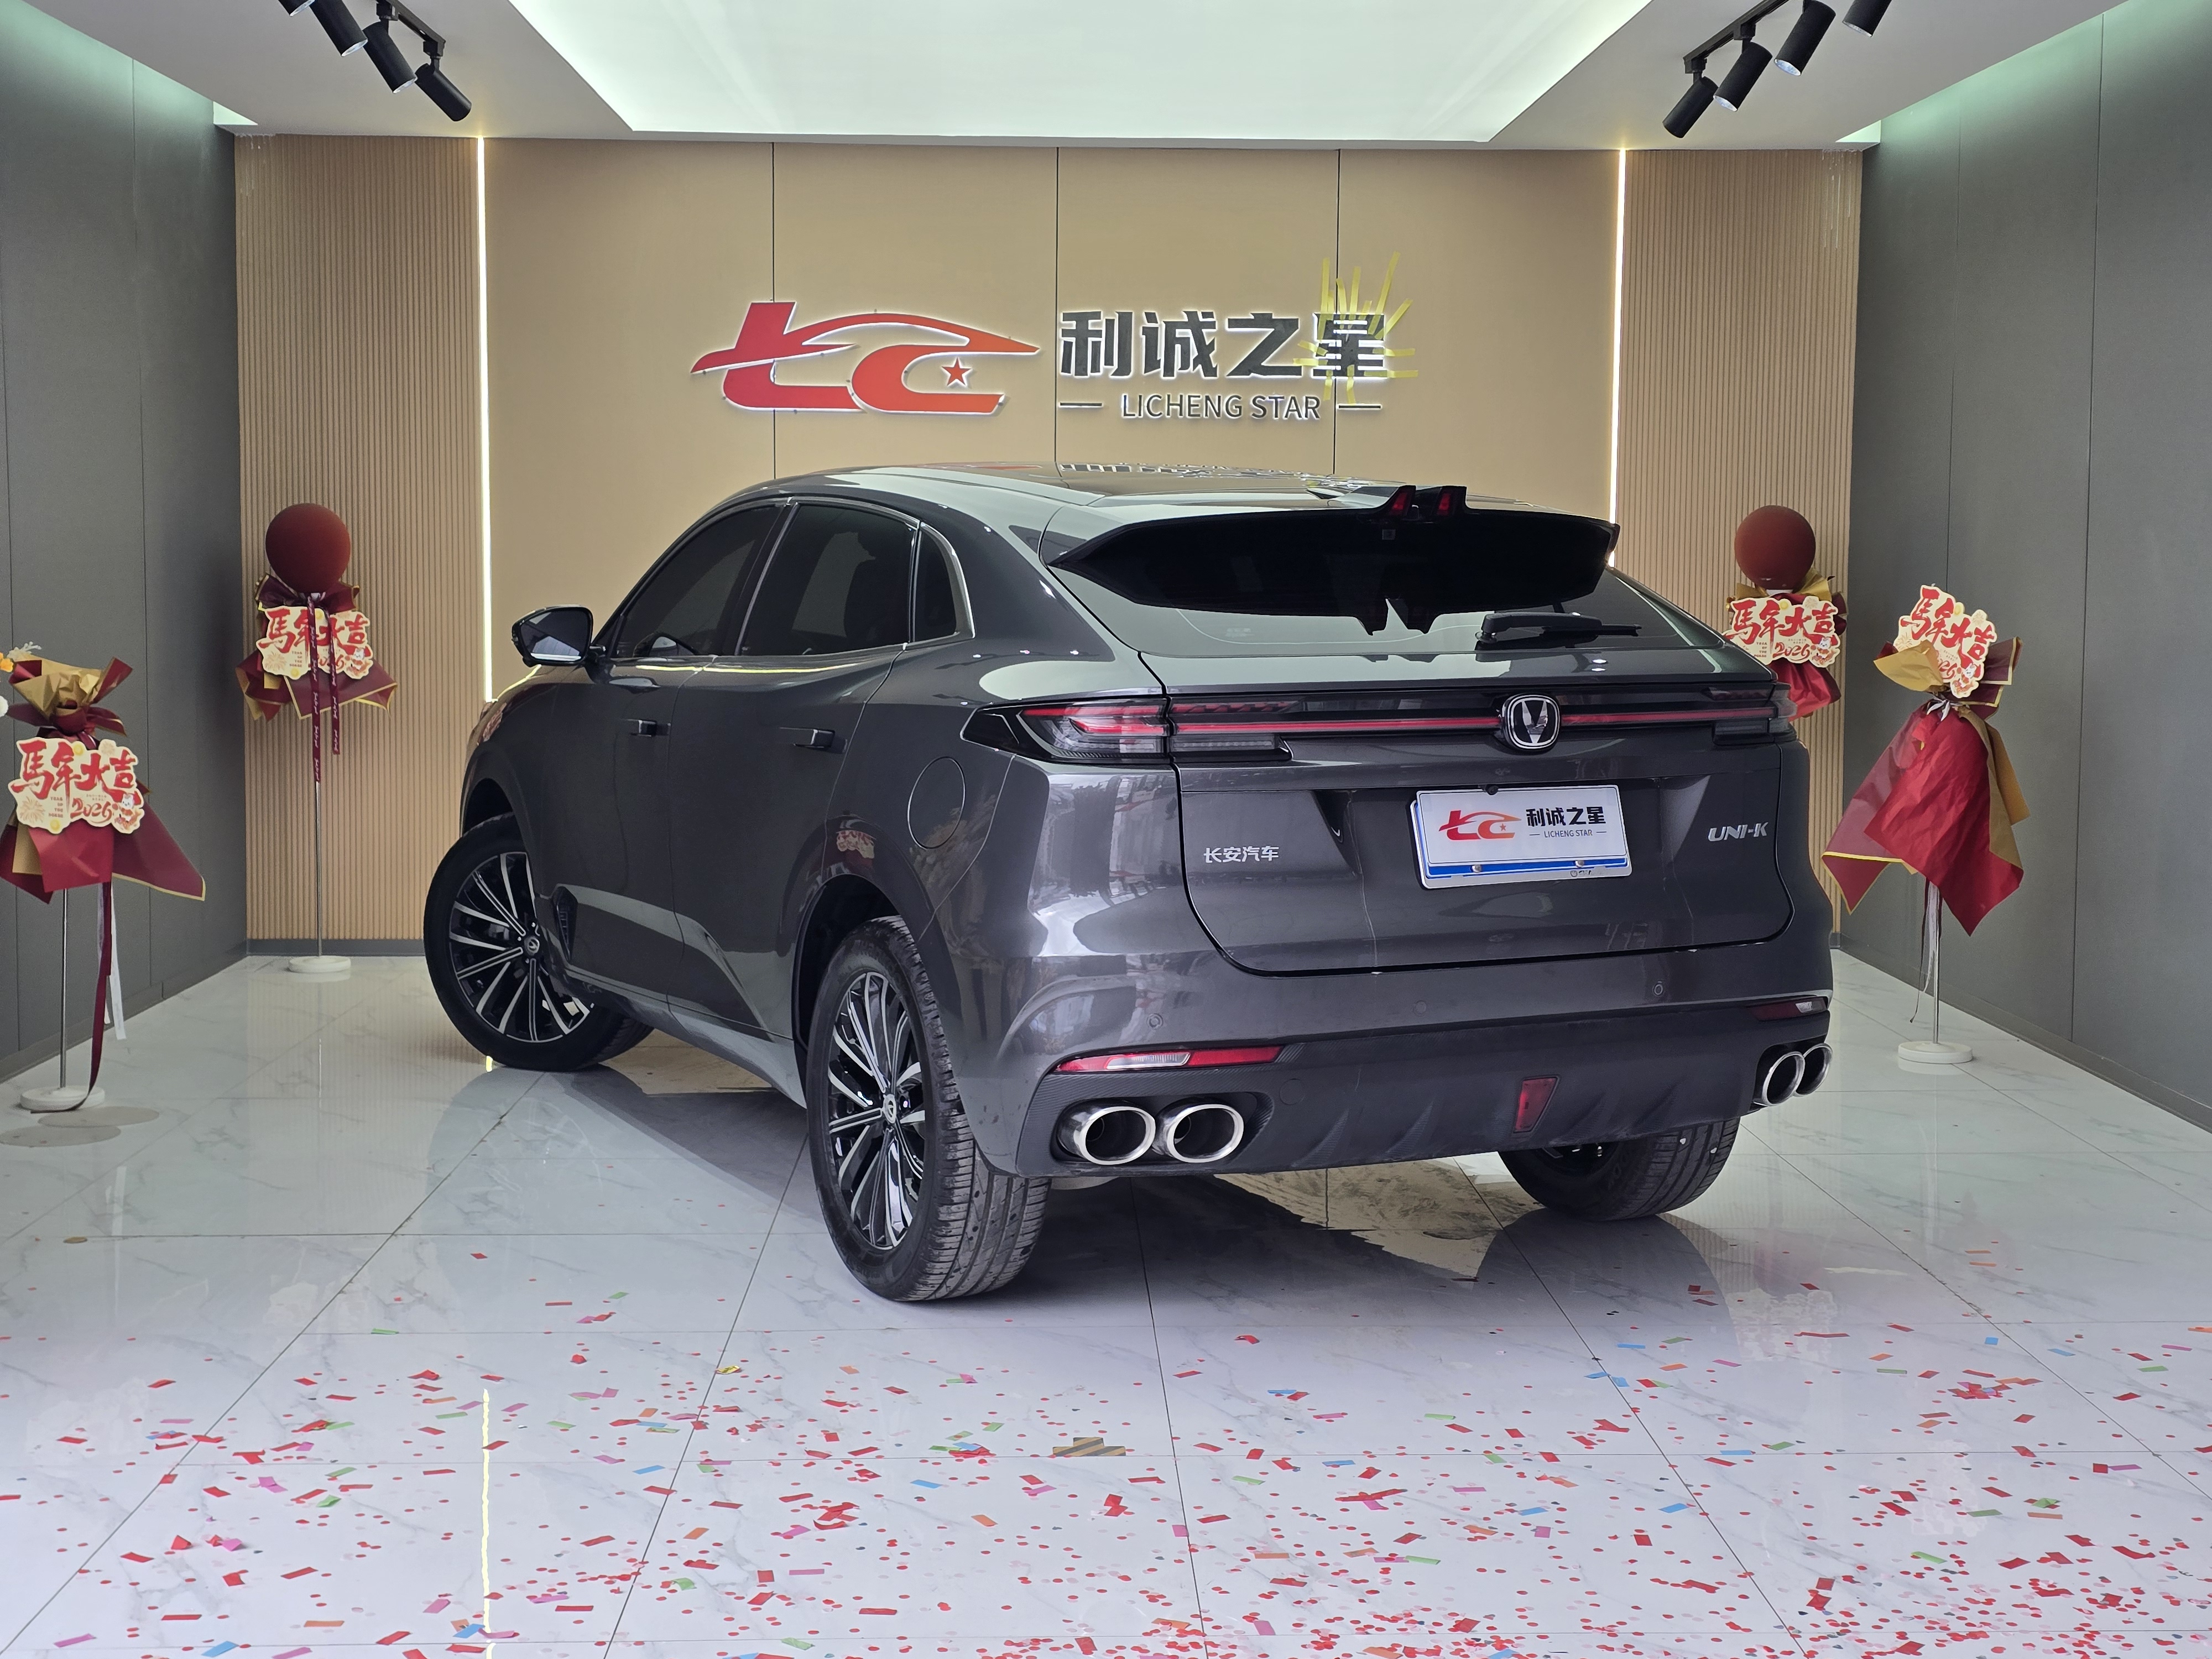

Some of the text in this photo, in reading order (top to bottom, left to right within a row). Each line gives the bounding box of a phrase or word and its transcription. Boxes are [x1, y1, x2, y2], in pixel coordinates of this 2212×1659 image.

[1061, 310, 1387, 378] 利诚之星
[1123, 394, 1321, 419] LICHENG STAR
[1772, 642, 1810, 660] 2026
[70, 798, 112, 824] 2026
[1525, 806, 1606, 827] 利诚之星
[1543, 830, 1574, 838] LICHENG
[1708, 822, 1768, 842] UNI-K
[1203, 846, 1280, 863] 长安汽车
